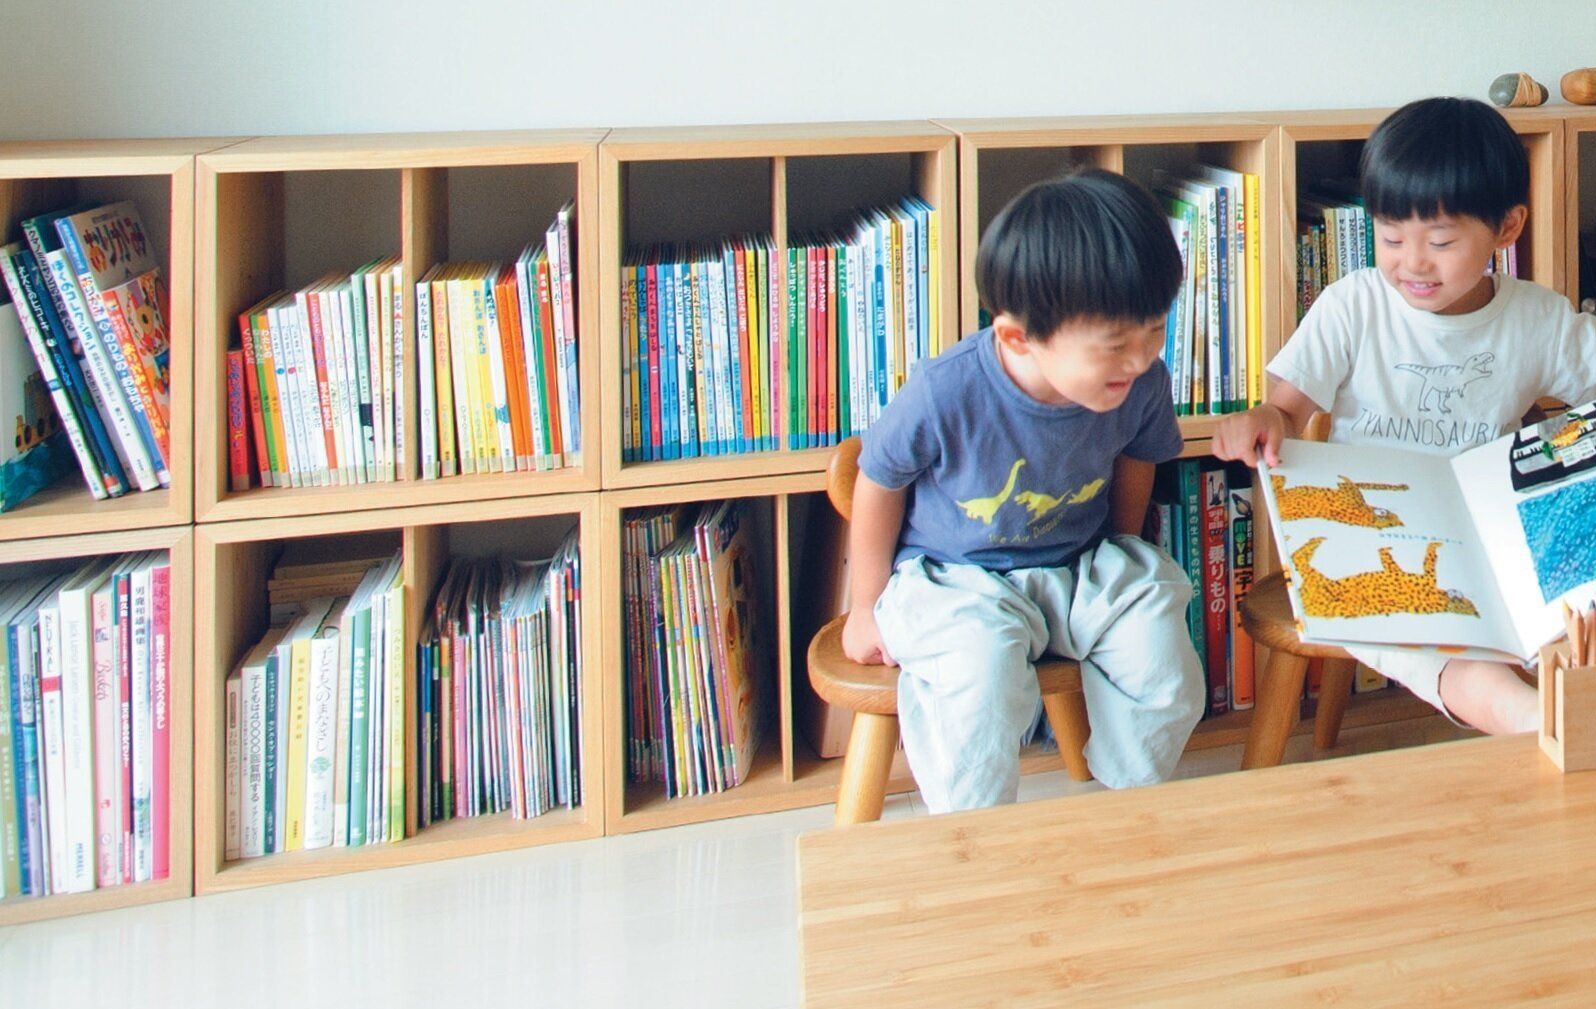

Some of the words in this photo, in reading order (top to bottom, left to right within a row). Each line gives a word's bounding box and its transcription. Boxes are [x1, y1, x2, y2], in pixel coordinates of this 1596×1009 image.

[1188, 494, 1201, 598] 世界の生きものMAP
[1208, 544, 1226, 614] 乗りもの
[315, 644, 332, 753] 子どもへのまなざし
